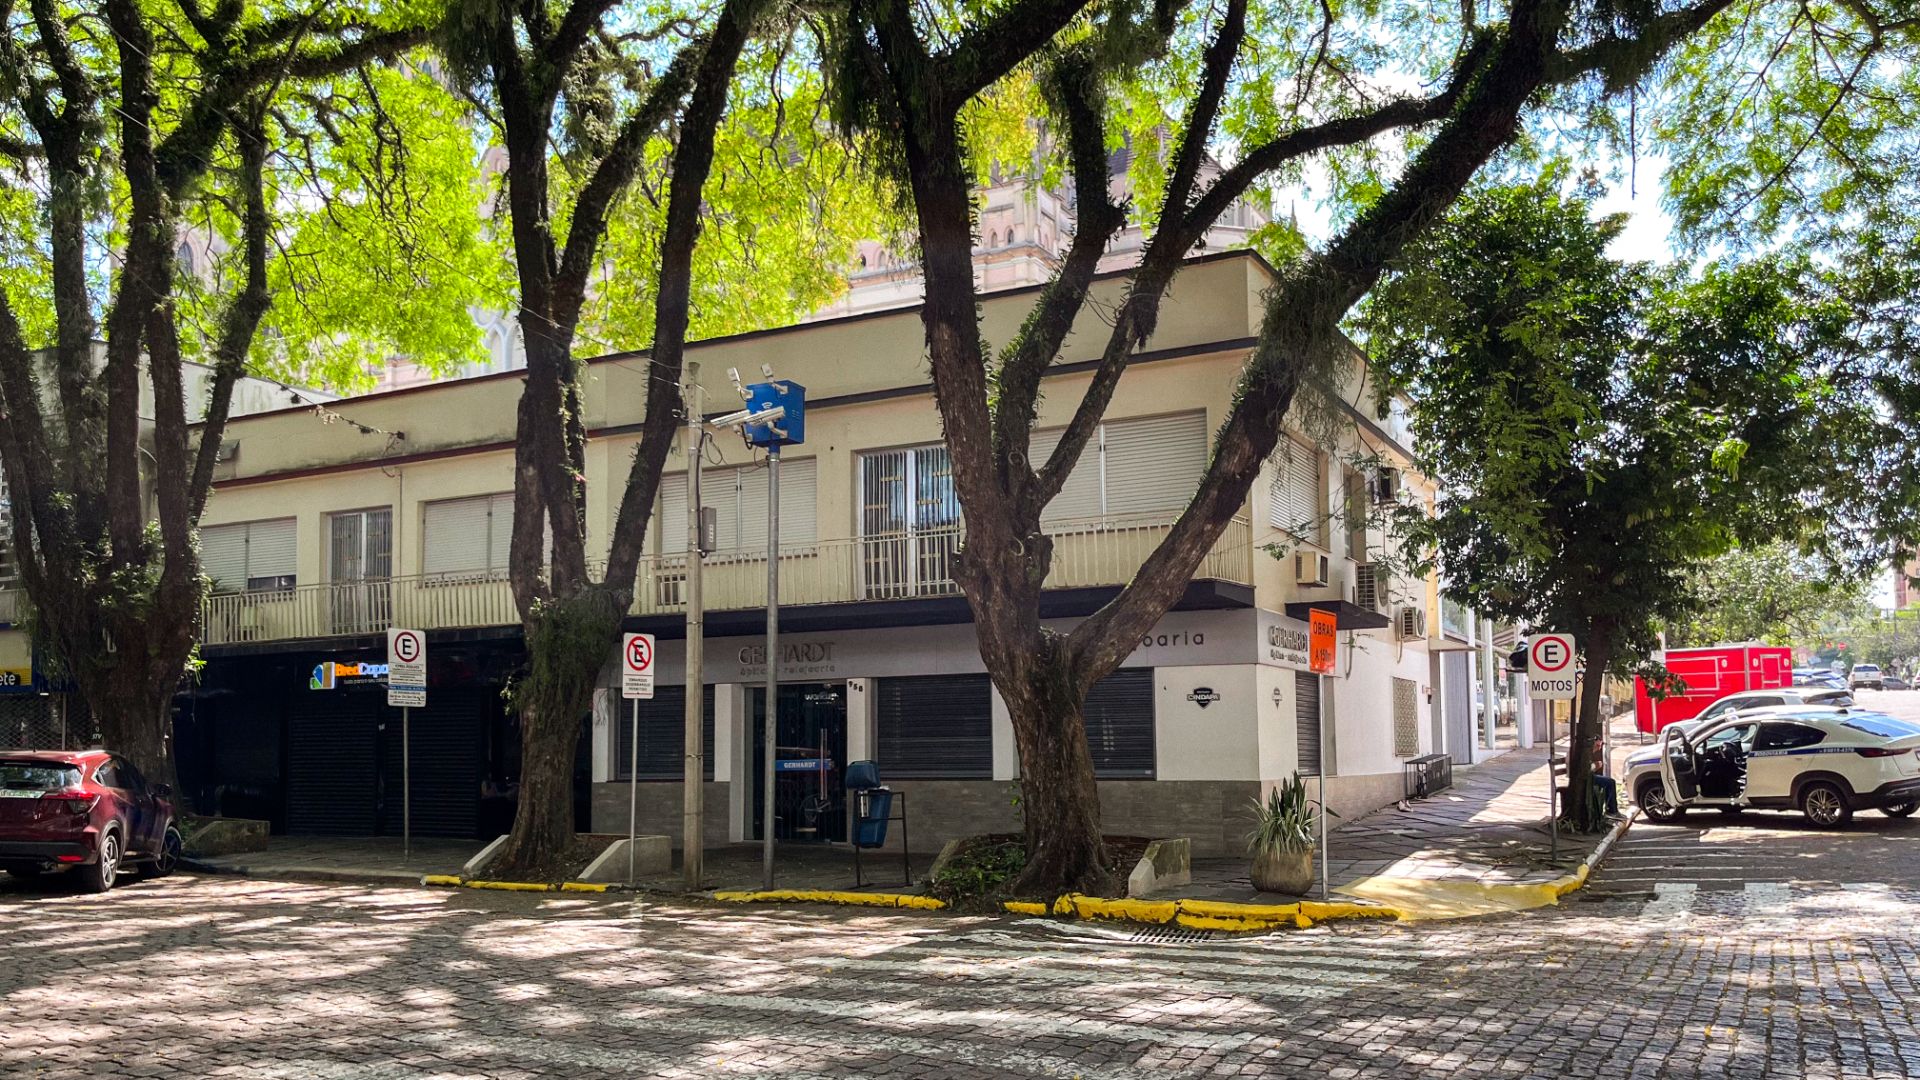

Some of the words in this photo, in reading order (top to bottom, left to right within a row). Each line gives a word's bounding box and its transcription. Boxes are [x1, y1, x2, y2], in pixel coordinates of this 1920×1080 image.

[1313, 622, 1334, 637] OBRAS
[402, 639, 412, 655] E
[1544, 645, 1558, 663] E
[1531, 680, 1572, 691] MOTOS
